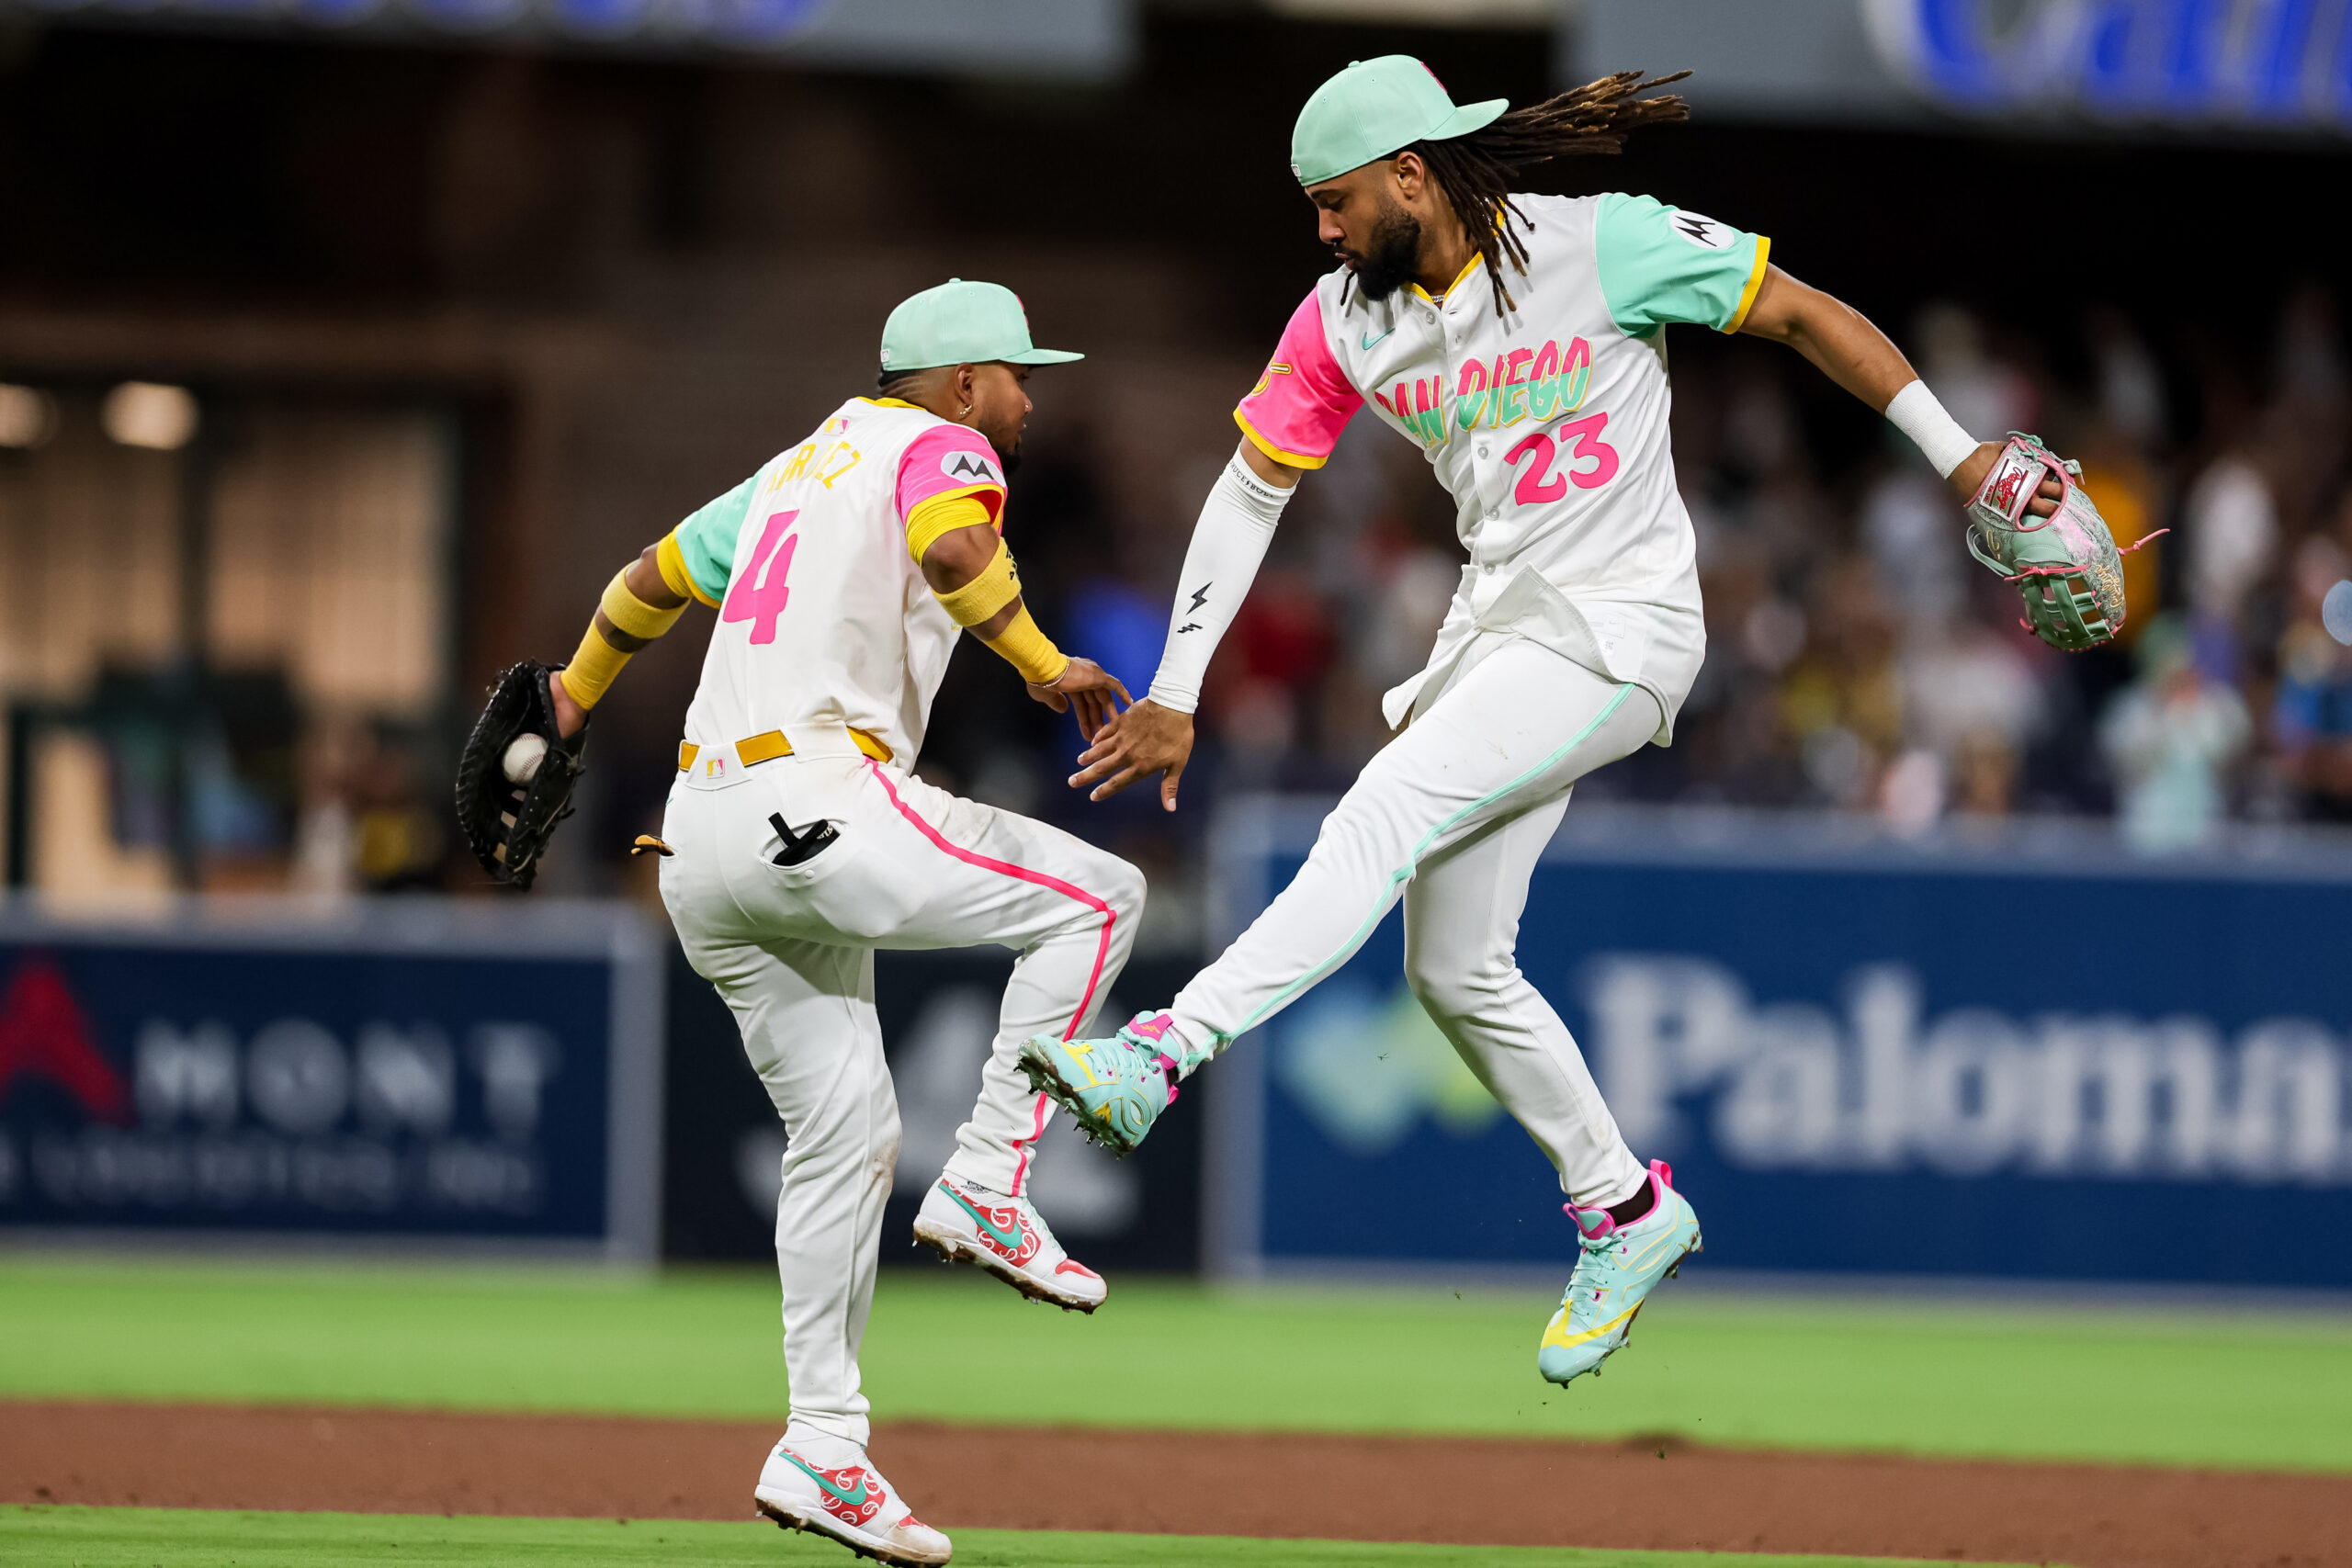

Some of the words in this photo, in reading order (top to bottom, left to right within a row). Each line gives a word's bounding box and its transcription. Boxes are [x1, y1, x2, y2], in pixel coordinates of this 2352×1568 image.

[1455, 335, 1593, 434] DIEGO
[1503, 411, 1620, 506] 23
[722, 509, 800, 645] 4
[1578, 953, 2352, 1181] Paloma
